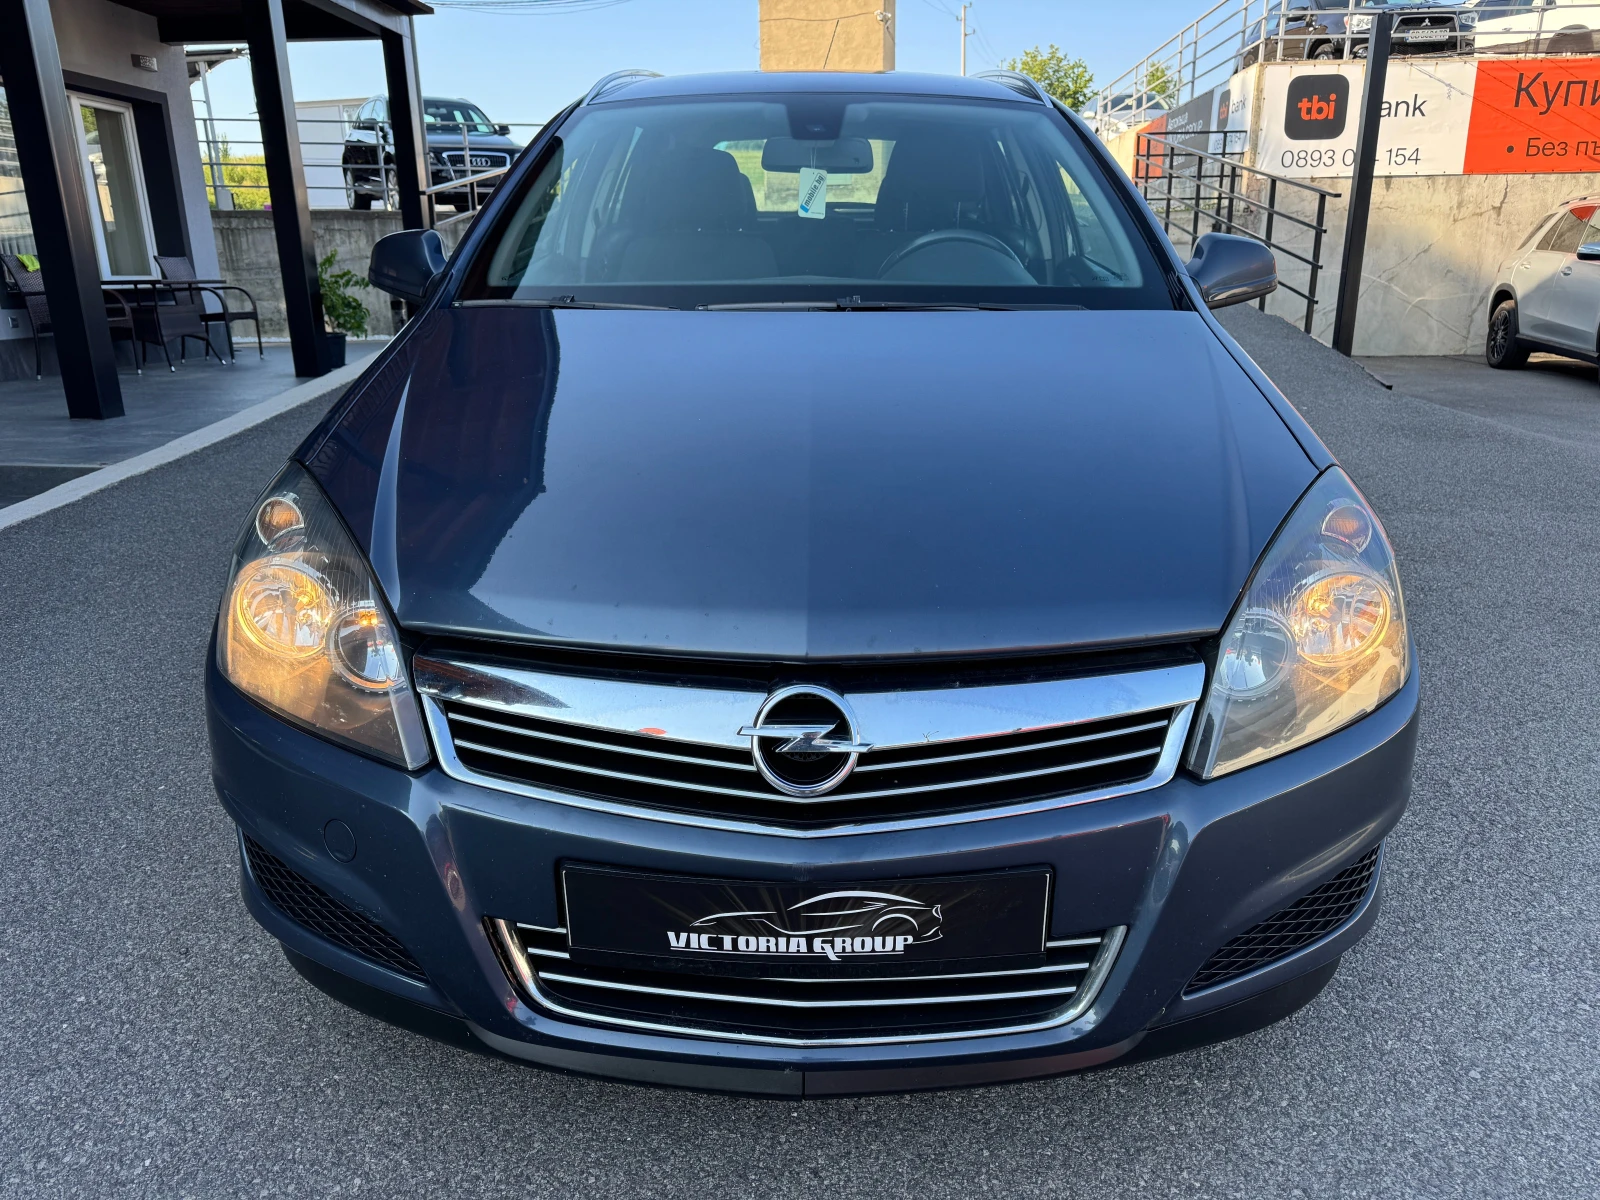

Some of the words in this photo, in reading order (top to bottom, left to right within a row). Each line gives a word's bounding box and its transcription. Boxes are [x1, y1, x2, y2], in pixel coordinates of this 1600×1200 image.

[1231, 95, 1246, 114] bank
[1297, 93, 1337, 120] tbi
[1380, 94, 1427, 117] ank
[1281, 149, 1336, 169] 0893
[1386, 147, 1422, 166] 154
[1525, 137, 1569, 157] Без
[804, 175, 824, 206] mobile.bg
[666, 931, 808, 953] VICTORIA
[813, 935, 914, 961] GROUP
